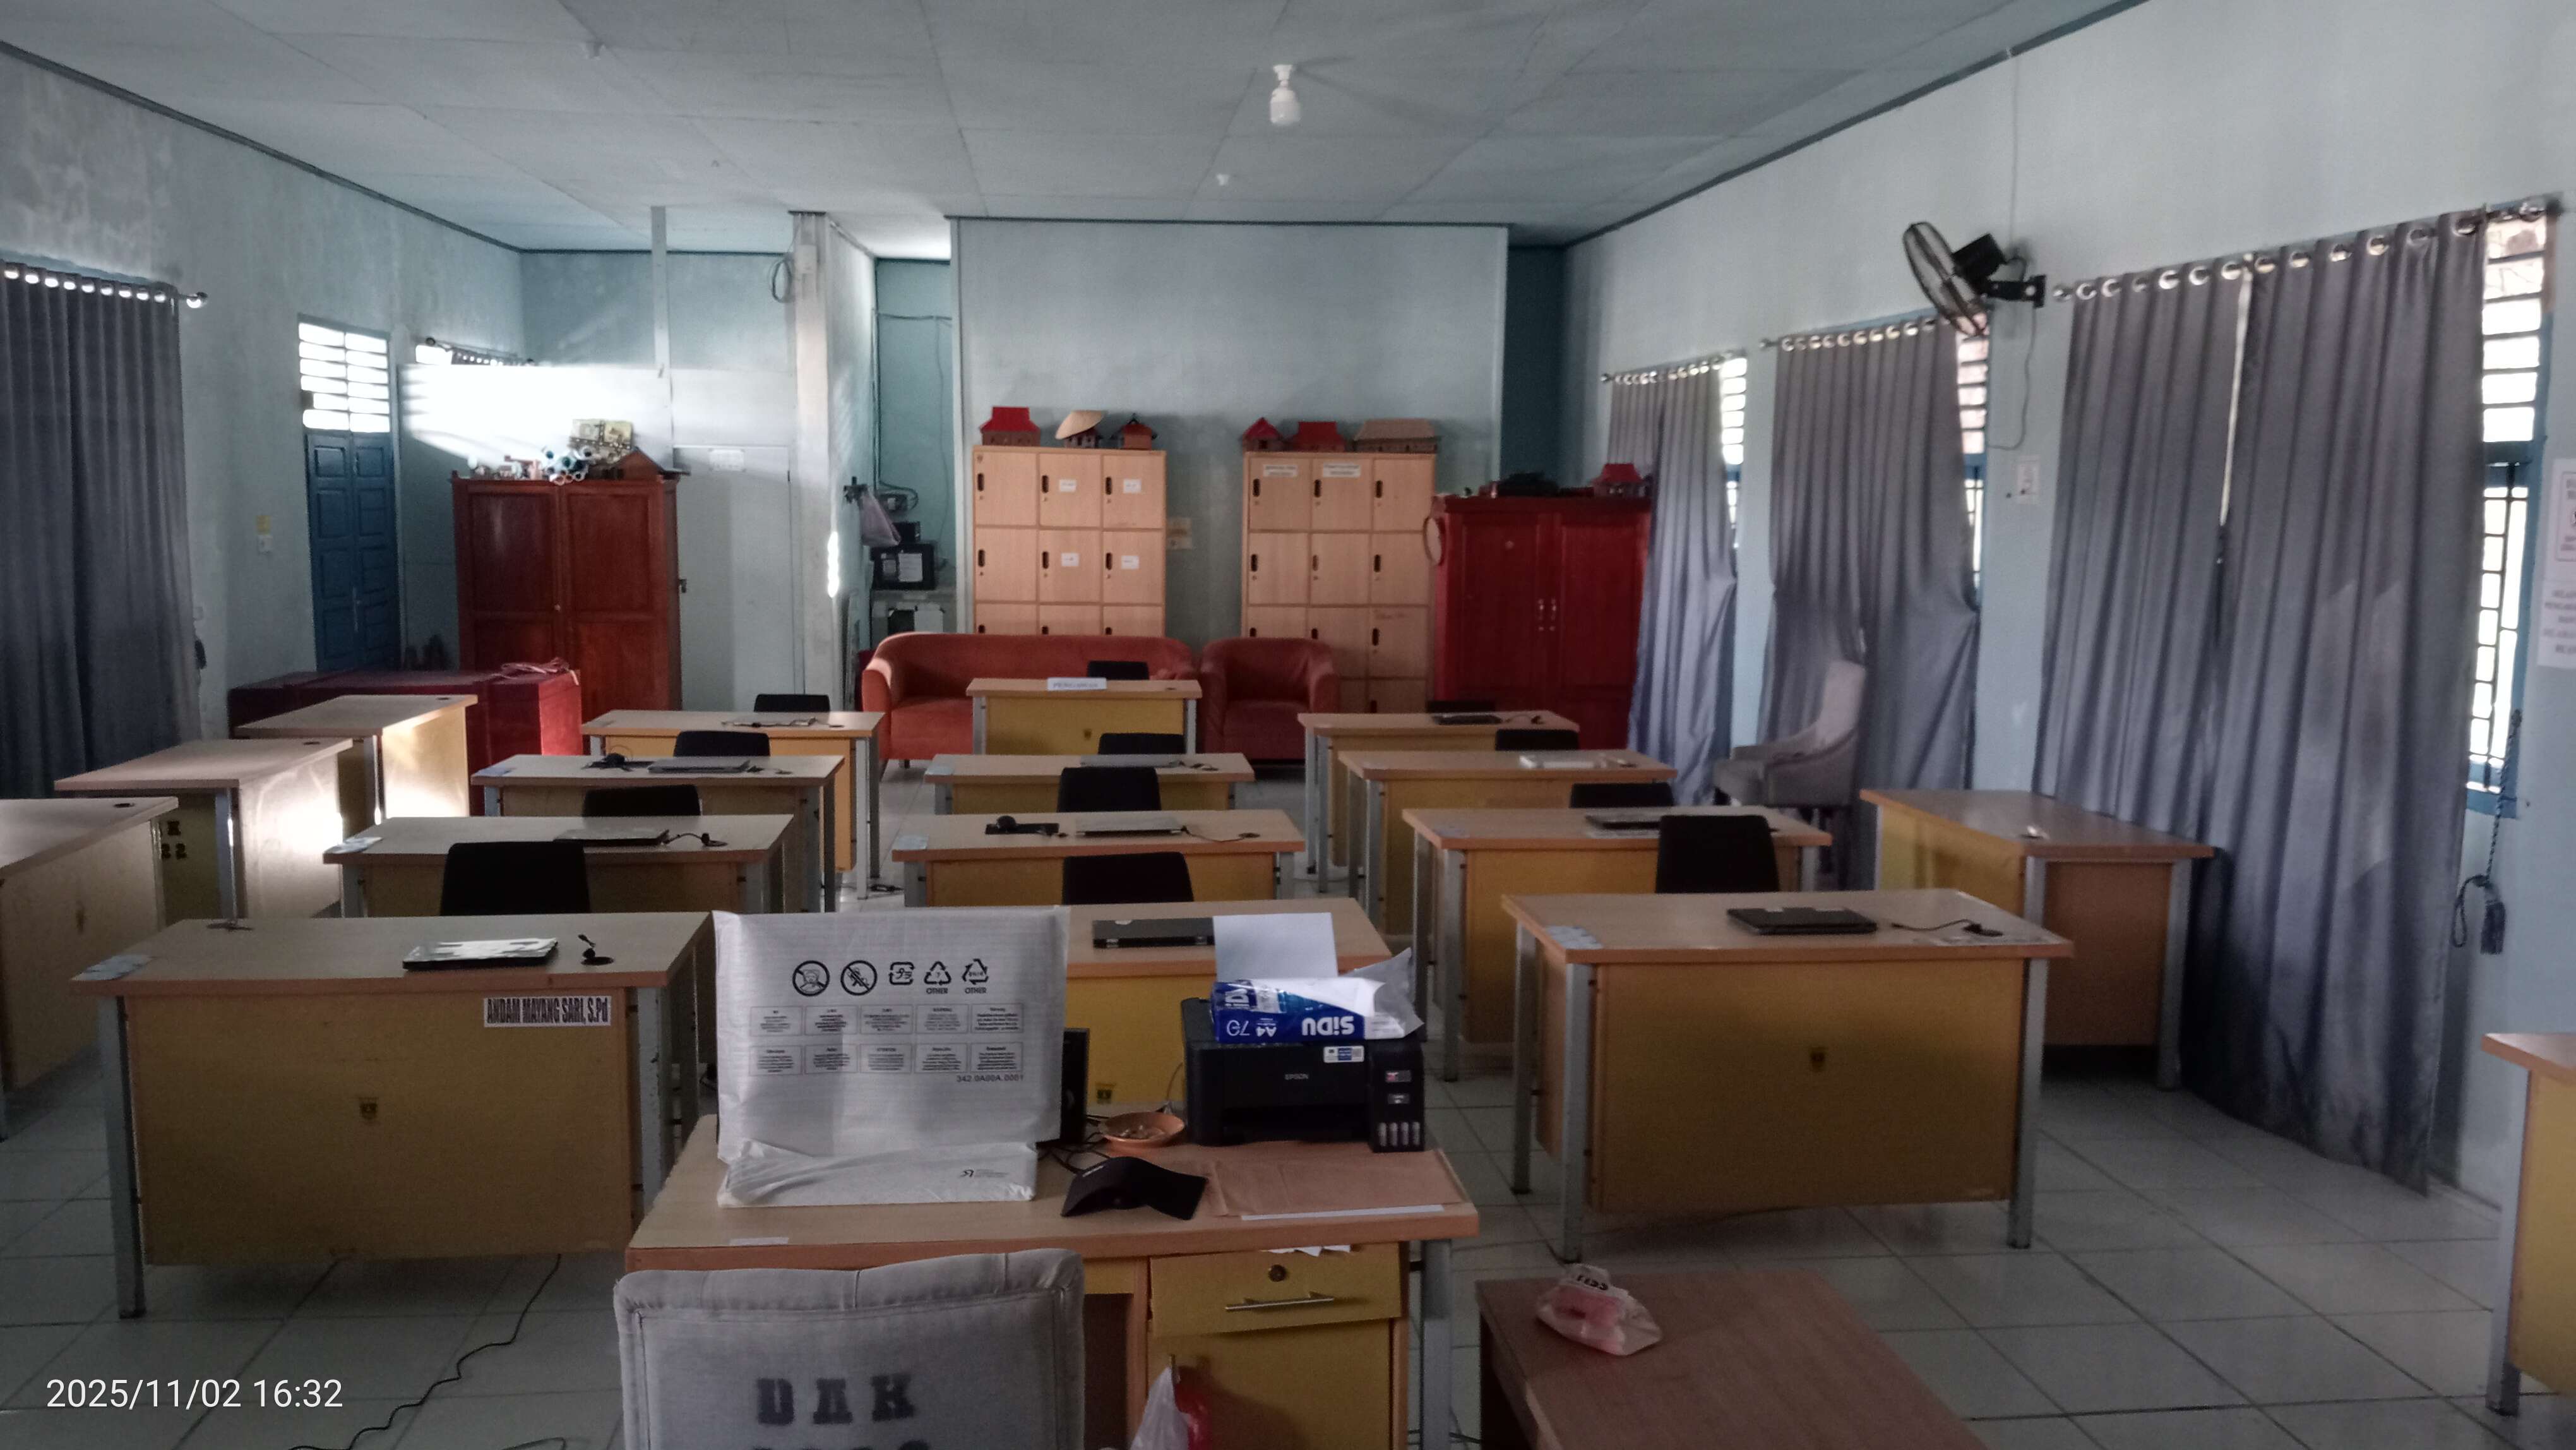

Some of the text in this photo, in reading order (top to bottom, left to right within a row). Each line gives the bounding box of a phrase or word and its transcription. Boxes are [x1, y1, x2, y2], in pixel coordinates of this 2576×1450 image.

[964, 986, 987, 995] OTHER
[487, 998, 520, 1023] ANDAM
[522, 997, 559, 1023] MAYANG
[1255, 1026, 1277, 1037] A4
[756, 1375, 915, 1425] DAK
